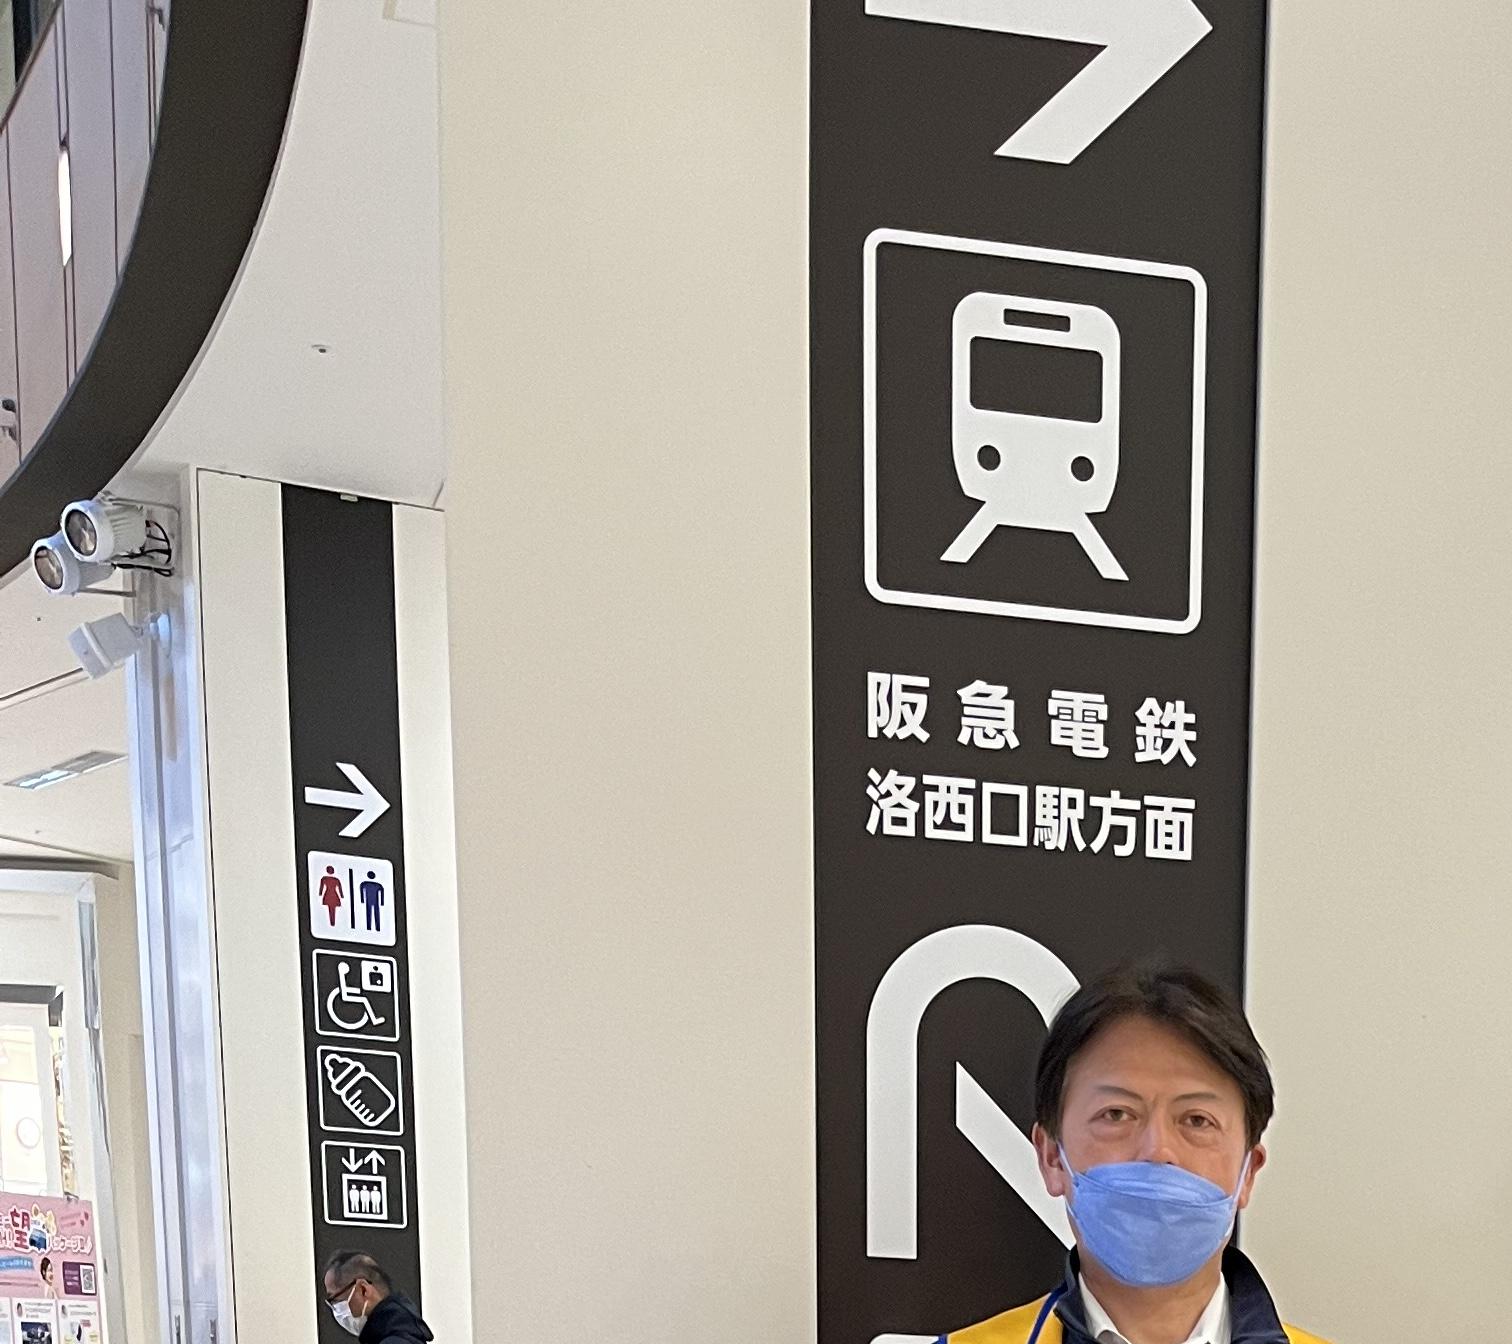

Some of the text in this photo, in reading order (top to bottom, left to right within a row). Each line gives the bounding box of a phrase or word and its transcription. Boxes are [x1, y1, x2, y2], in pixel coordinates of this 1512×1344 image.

[867, 672, 1197, 767] 阪急電鉄
[866, 768, 1196, 861] 洛西口駅方面
